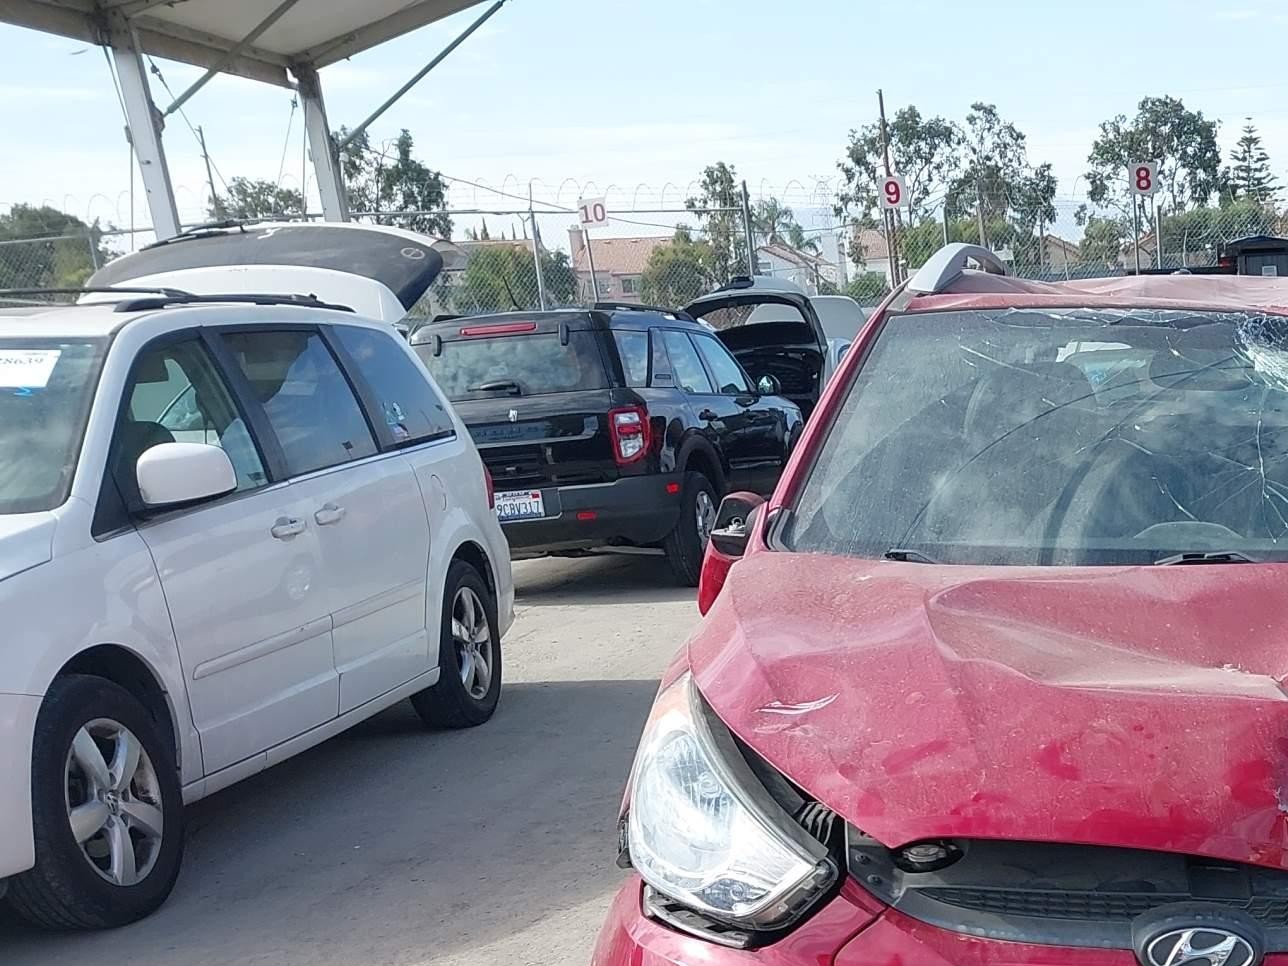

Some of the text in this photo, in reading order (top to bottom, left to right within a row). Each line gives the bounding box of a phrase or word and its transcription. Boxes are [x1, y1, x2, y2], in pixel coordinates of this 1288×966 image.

[1136, 166, 1152, 191] 8
[884, 180, 901, 205] 9
[579, 203, 606, 224] 10
